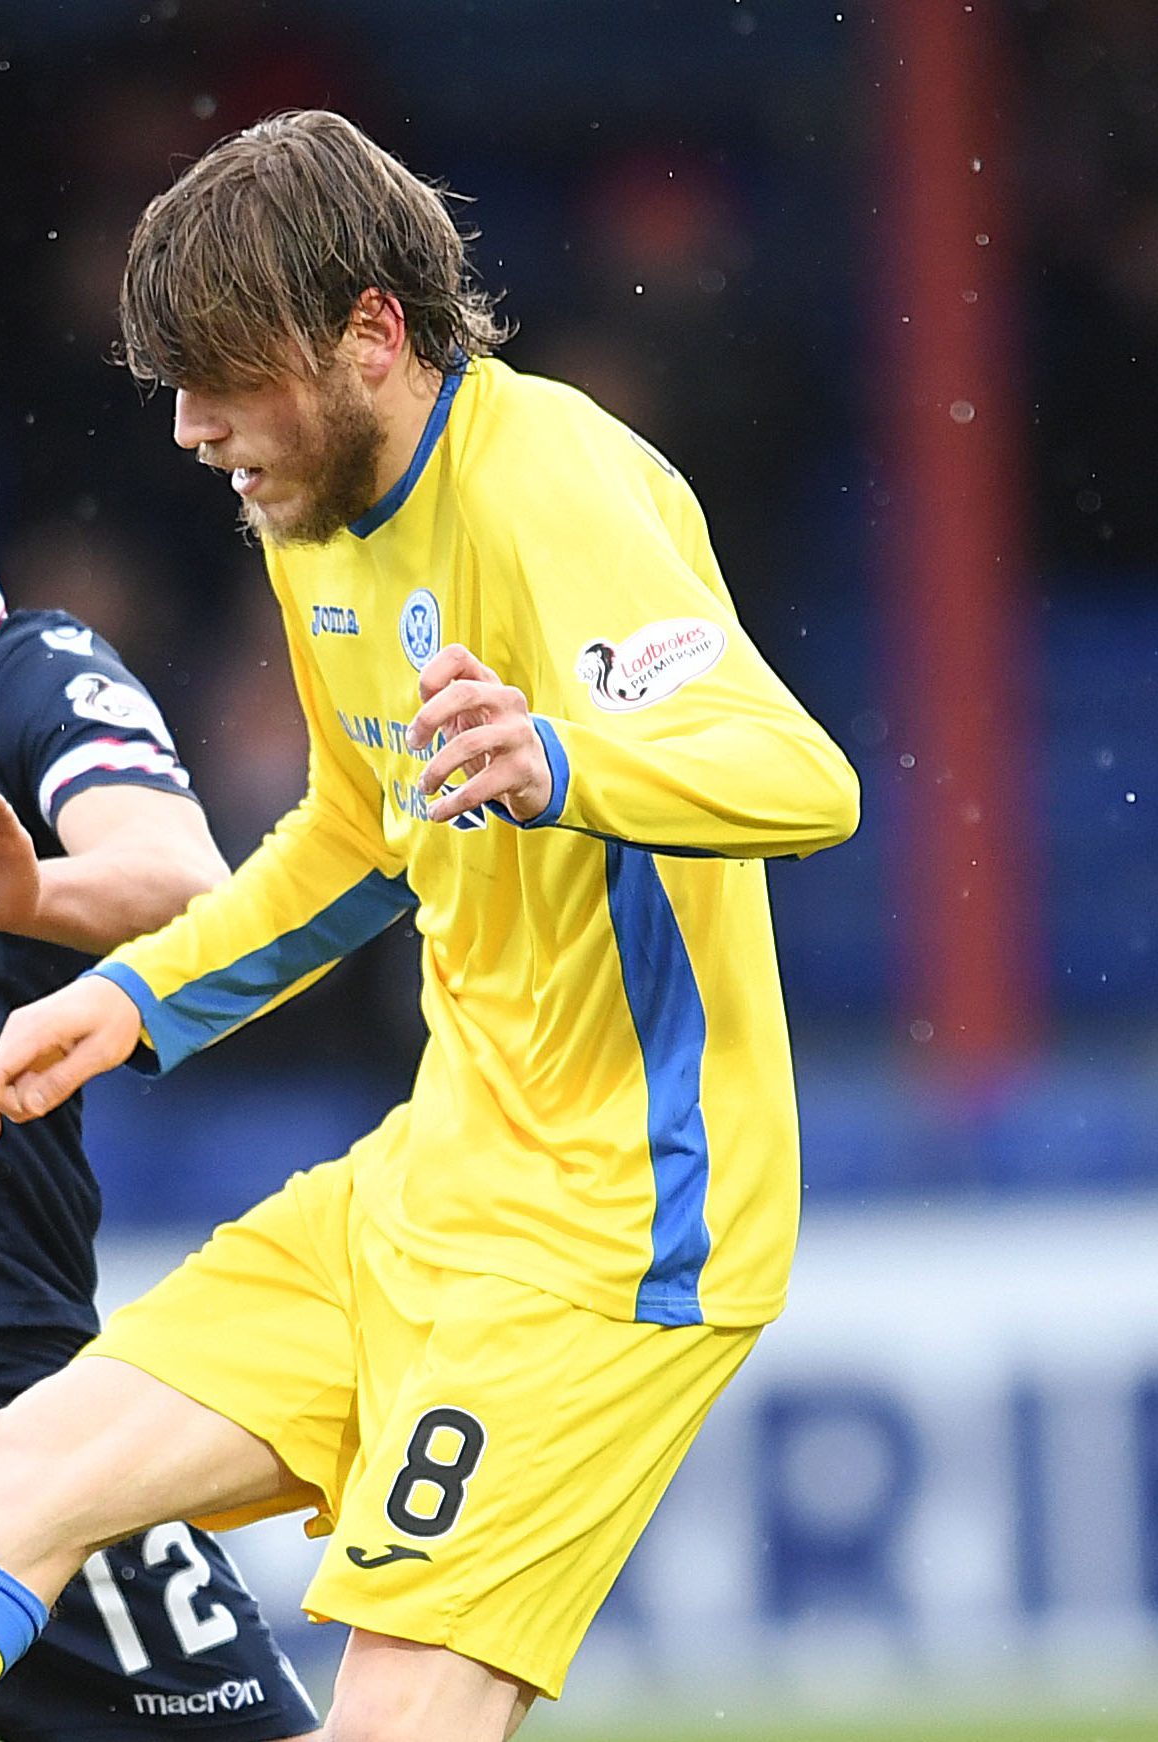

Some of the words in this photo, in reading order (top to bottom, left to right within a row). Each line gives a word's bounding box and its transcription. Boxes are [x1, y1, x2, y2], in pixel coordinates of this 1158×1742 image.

[311, 605, 360, 637] Joma
[620, 626, 706, 679] Ladbrokes
[630, 639, 712, 690] PREMIERSHIP
[384, 1405, 486, 1539] 8
[82, 1520, 238, 1677] 12
[133, 1676, 265, 1717] macron
